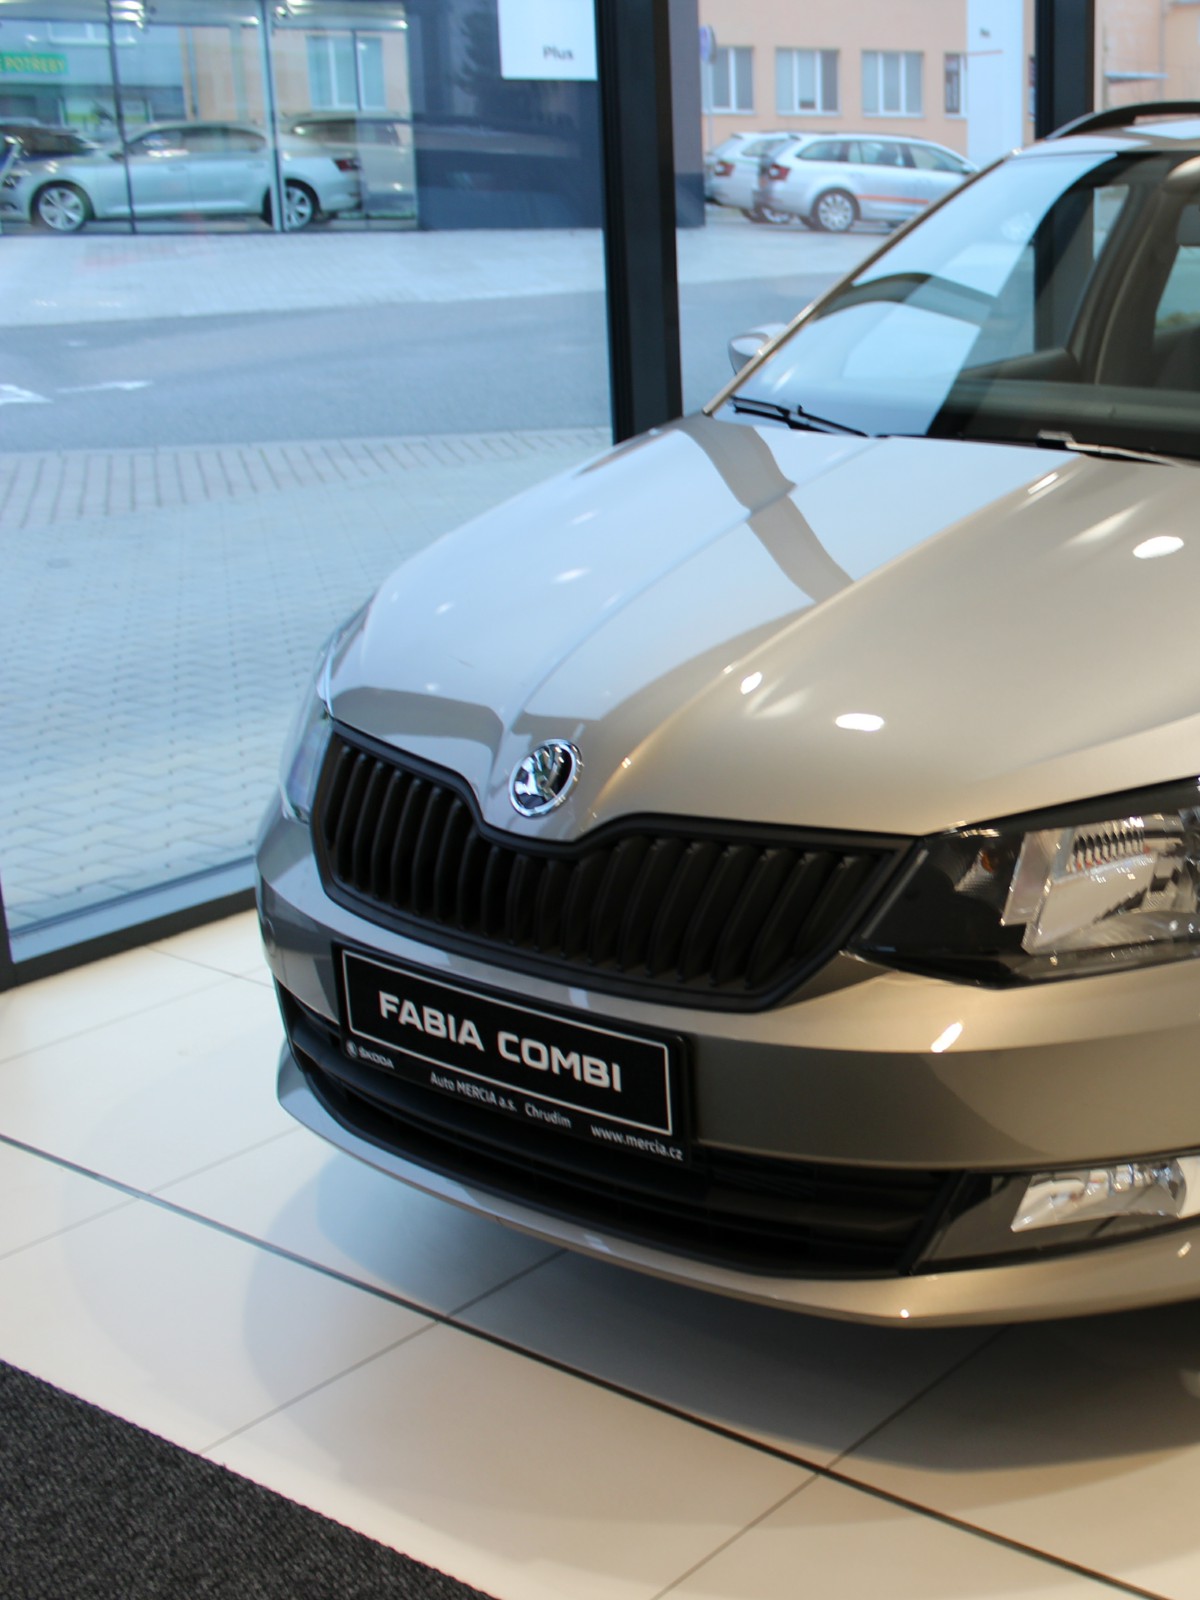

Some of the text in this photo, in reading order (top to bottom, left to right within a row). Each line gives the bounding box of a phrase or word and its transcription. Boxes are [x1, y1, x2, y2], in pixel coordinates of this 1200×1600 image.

[542, 44, 574, 61] Plus
[379, 990, 622, 1092] FABIA COMBI
[430, 1071, 455, 1092] Auto
[456, 1080, 497, 1105] MERCIA
[524, 1102, 572, 1129] Chrudim
[590, 1124, 684, 1161] www.mercia.cz
